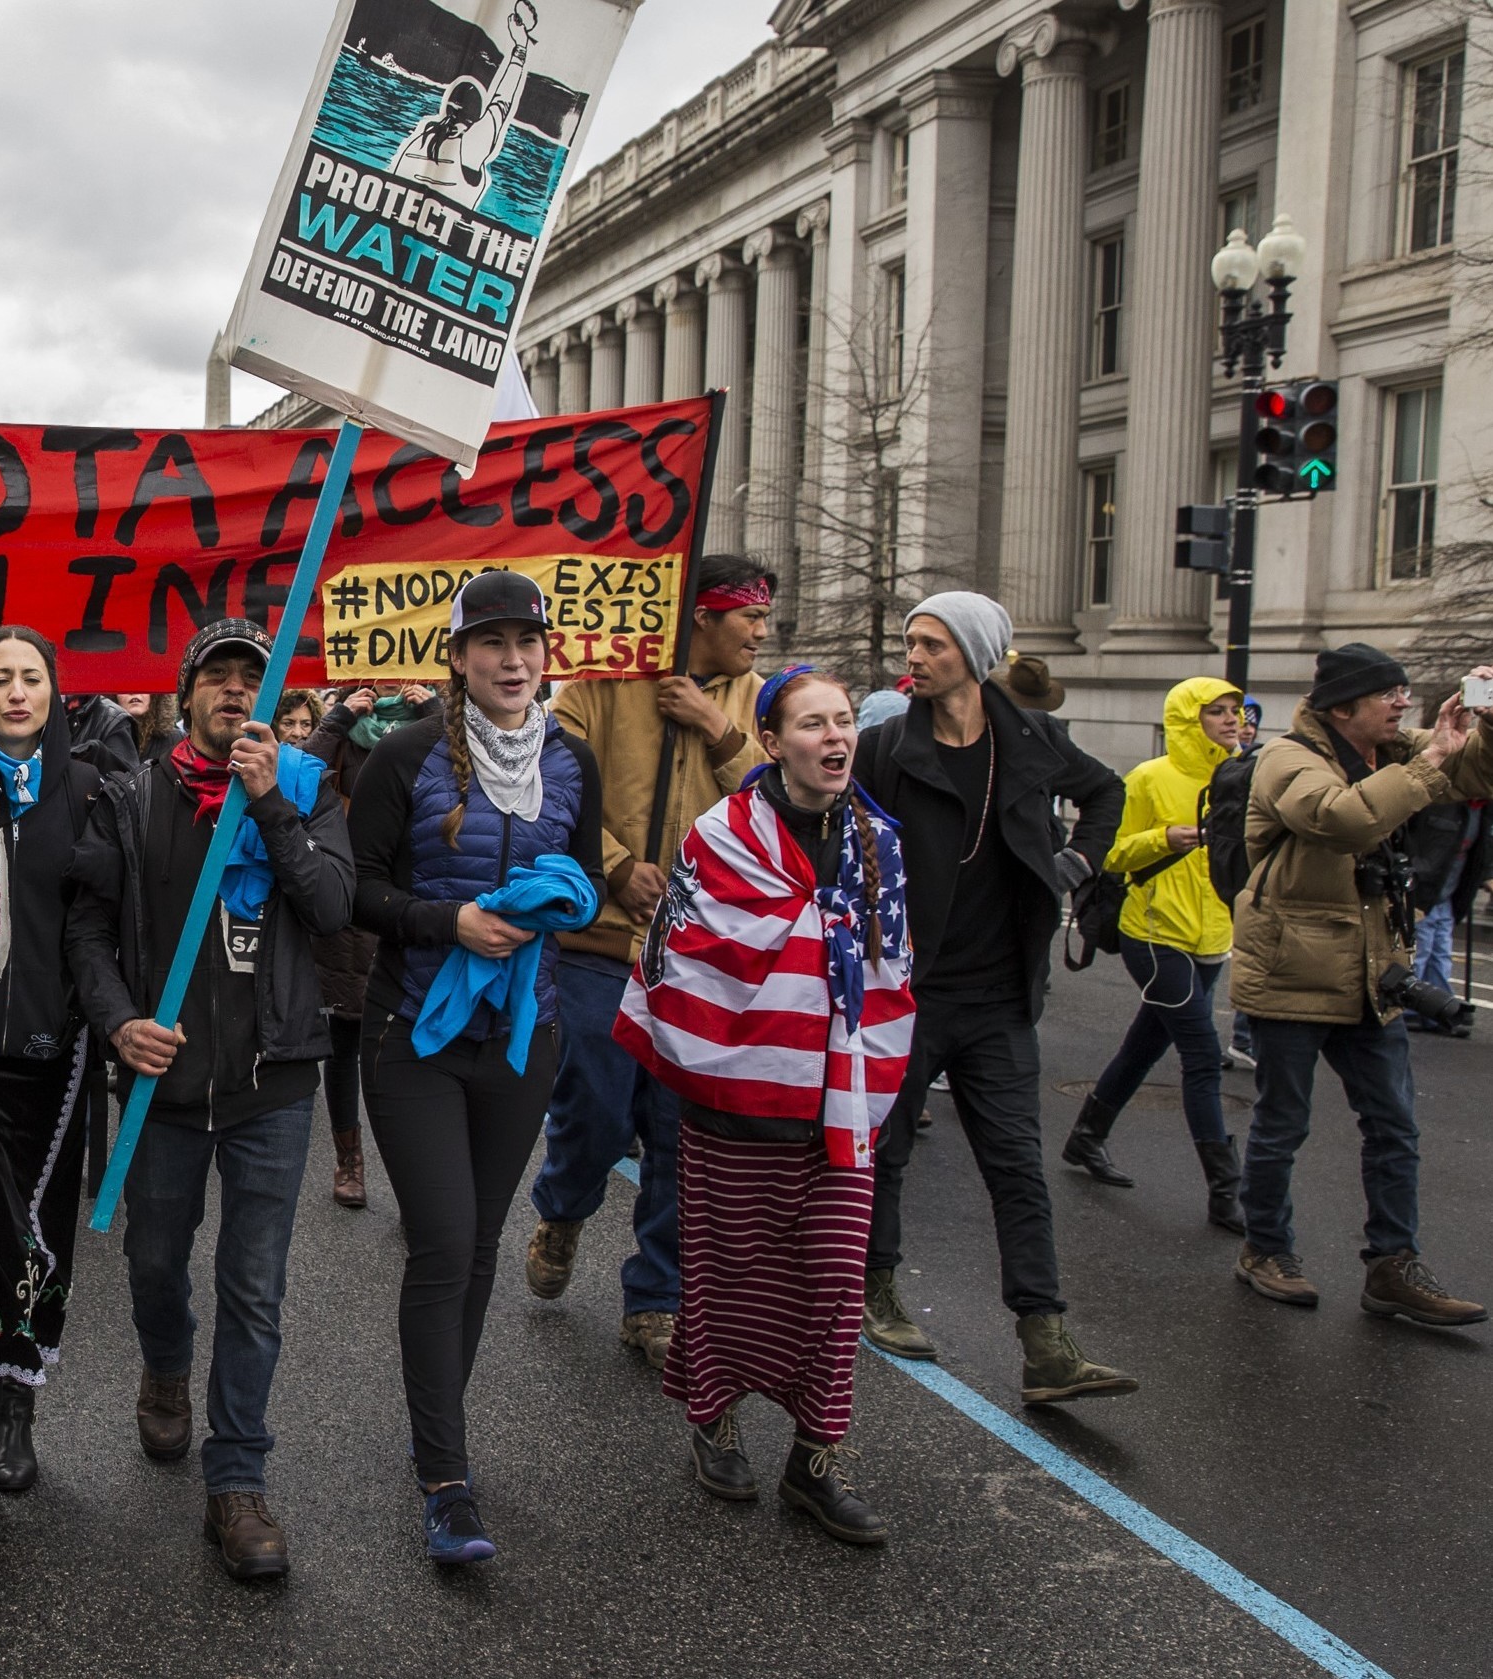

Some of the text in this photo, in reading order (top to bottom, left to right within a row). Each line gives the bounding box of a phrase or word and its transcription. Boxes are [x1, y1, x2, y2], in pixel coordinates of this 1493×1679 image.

[298, 193, 515, 325] WATER
[305, 153, 536, 279] PROTECT THE
[269, 250, 504, 372] DEFEND THE LAND
[333, 311, 350, 321] ART
[350, 317, 362, 326] BY
[397, 338, 431, 357] REBELDE
[259, 418, 697, 548] ACCESS
[326, 626, 452, 668] #DIVE
[544, 633, 665, 672] RISE
